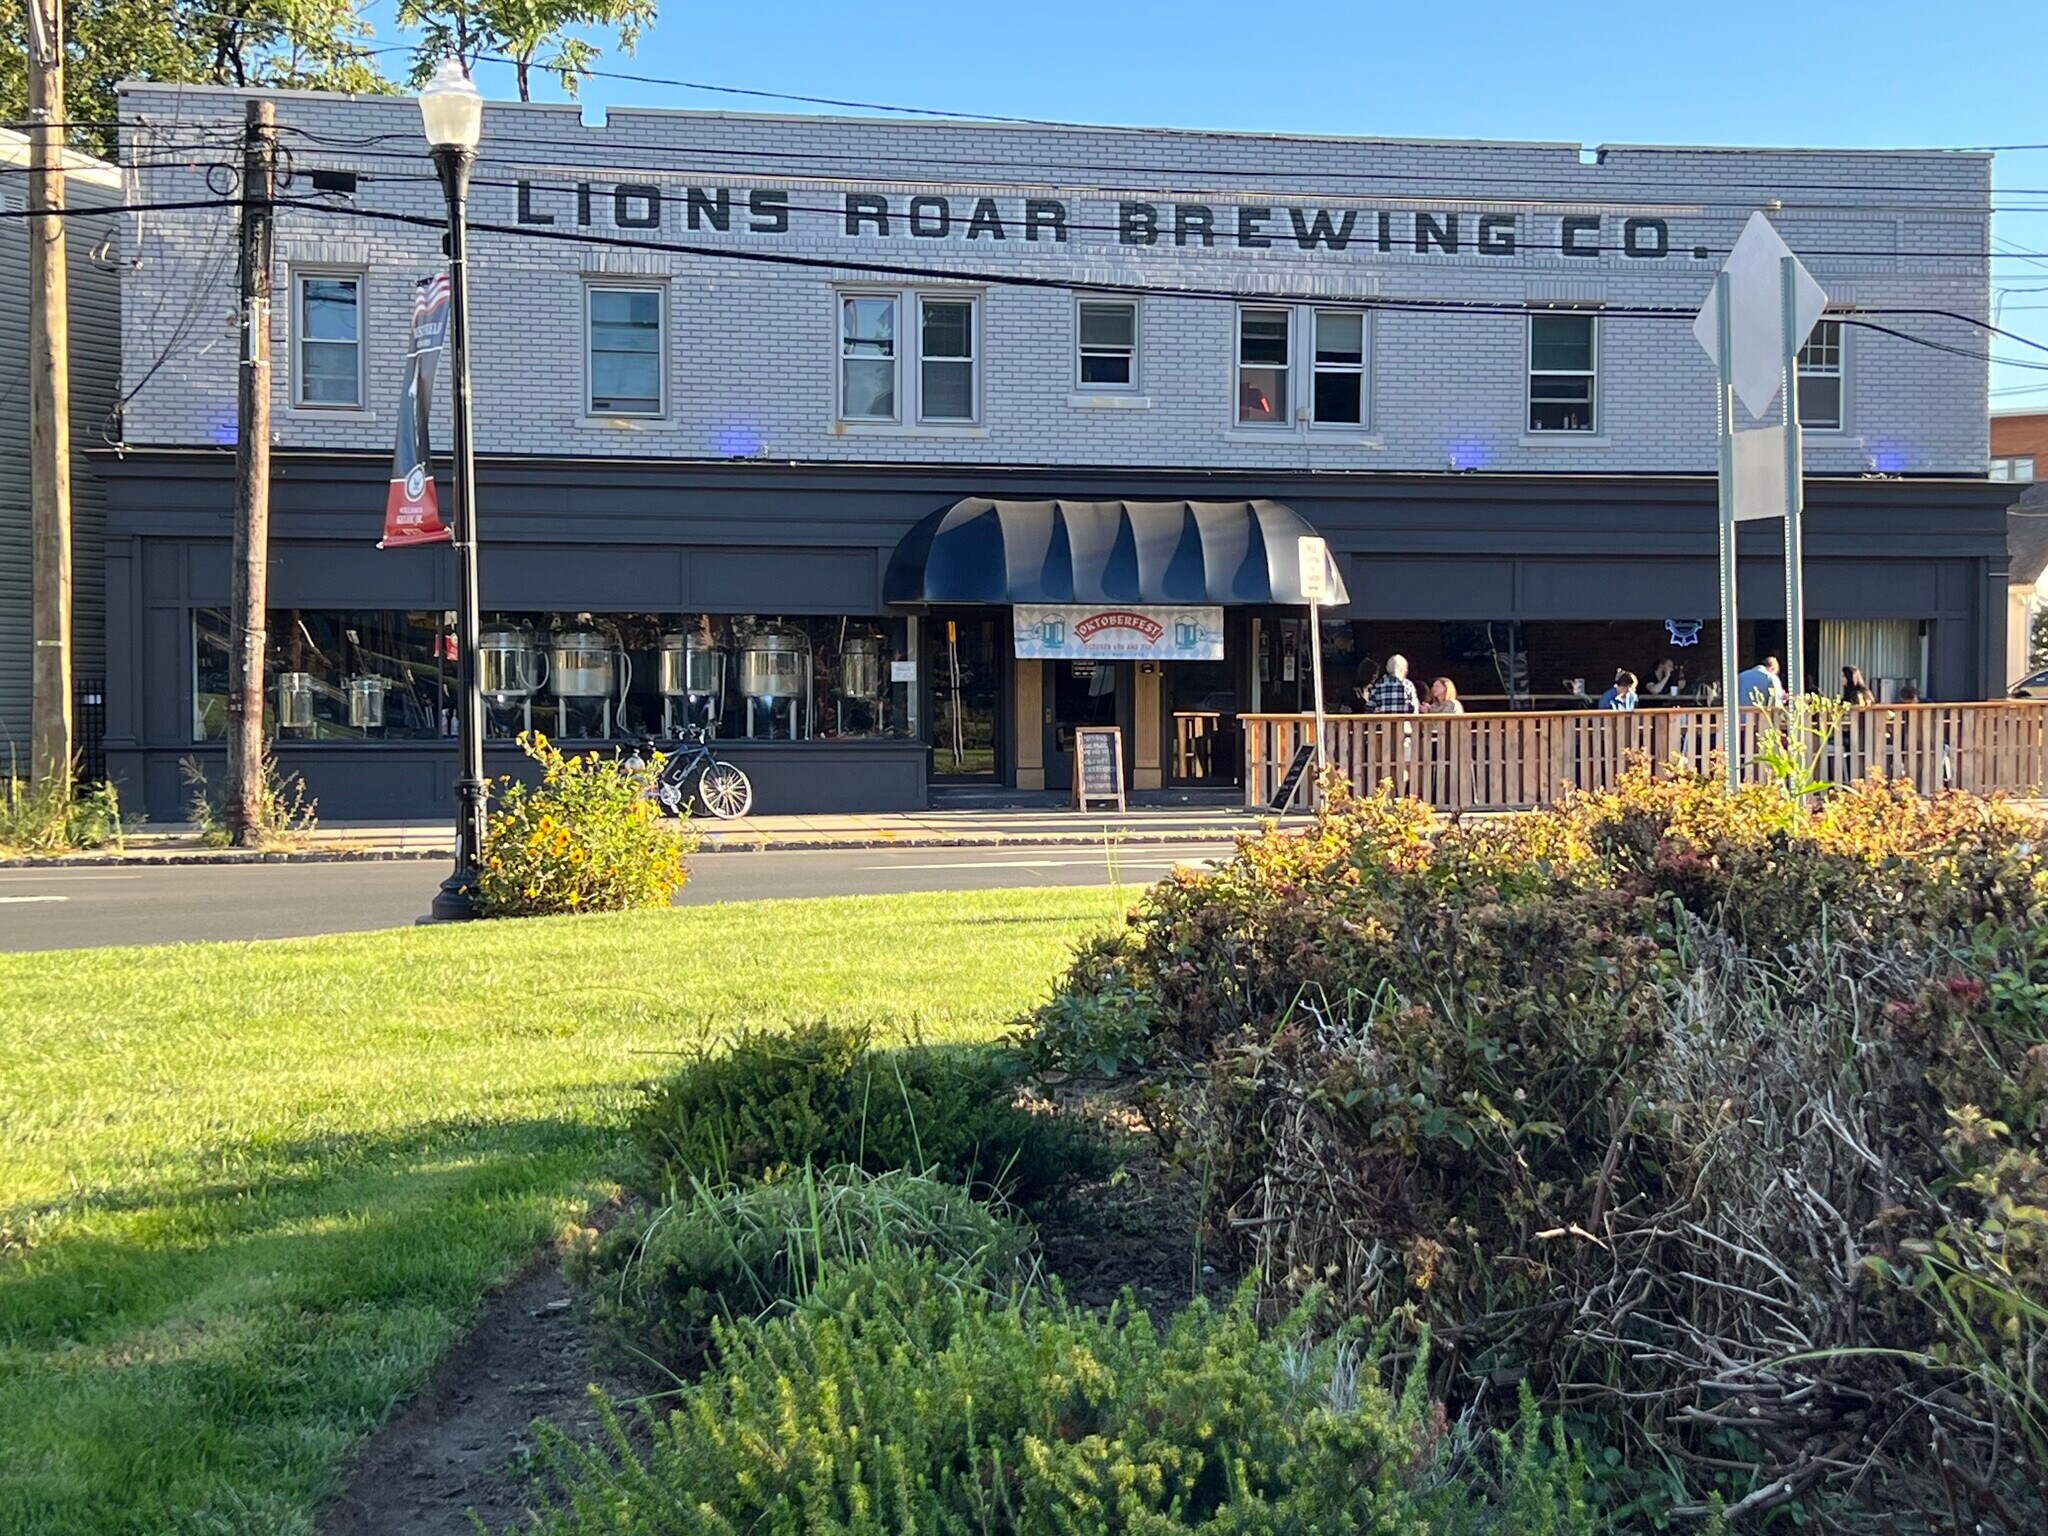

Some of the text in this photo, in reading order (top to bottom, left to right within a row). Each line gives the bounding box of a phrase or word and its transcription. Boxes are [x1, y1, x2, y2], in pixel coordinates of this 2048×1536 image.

[514, 180, 1709, 260] LIONS ROAR BREWING CO.
[1079, 614, 1161, 635] OKTOBERFEST
